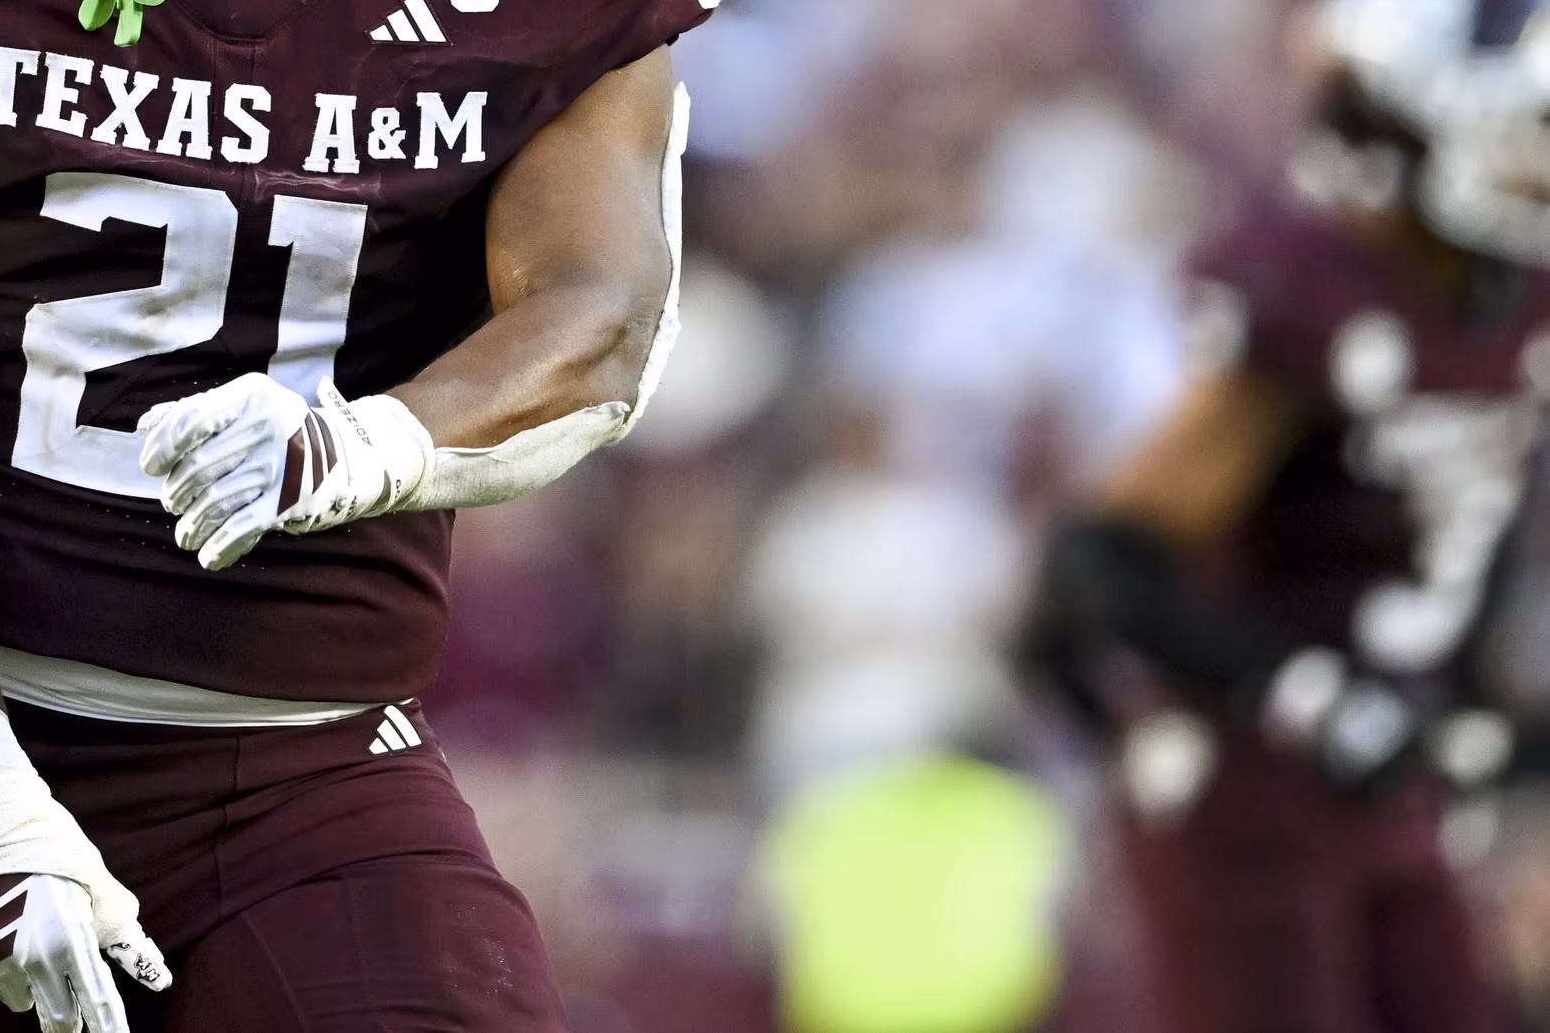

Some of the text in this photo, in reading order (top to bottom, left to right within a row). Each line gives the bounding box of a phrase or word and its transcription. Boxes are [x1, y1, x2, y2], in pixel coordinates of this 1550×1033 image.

[302, 91, 488, 174] A&M
[11, 172, 368, 500] 21
[327, 390, 374, 447] ADIZERO
